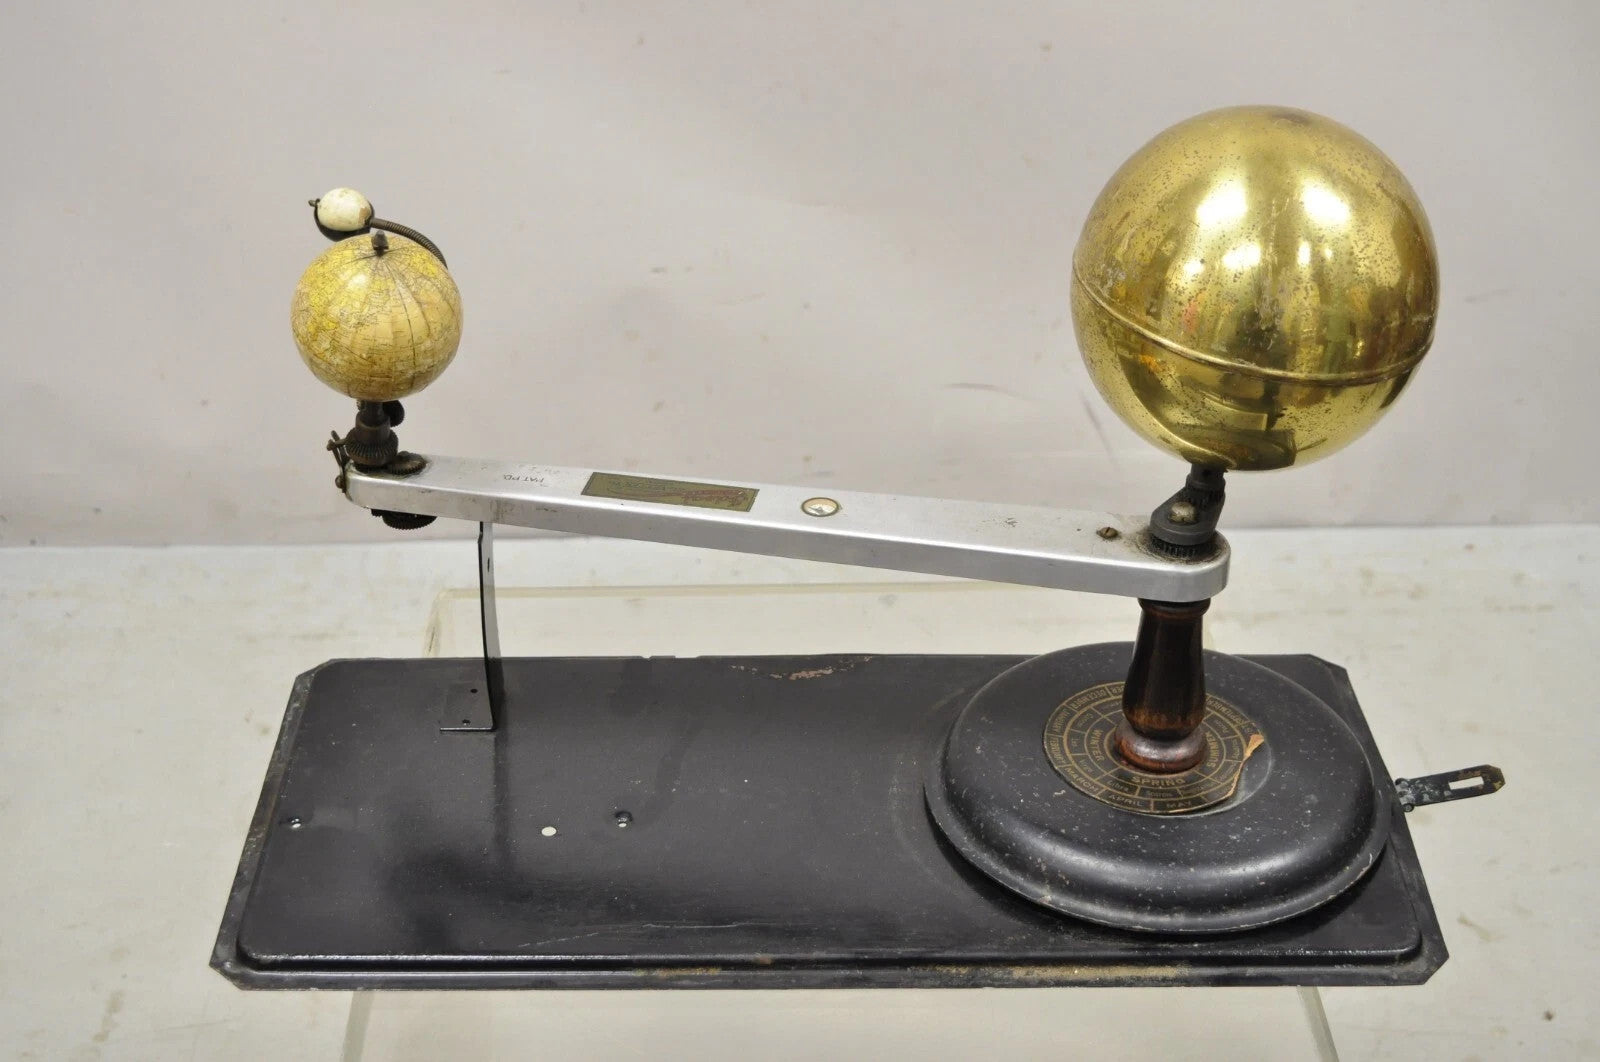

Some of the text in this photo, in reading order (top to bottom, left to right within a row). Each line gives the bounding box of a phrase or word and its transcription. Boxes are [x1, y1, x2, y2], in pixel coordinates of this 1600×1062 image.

[1070, 689, 1107, 709] DECEMBER
[1051, 708, 1071, 733] JANUARY
[1090, 729, 1106, 762] WINTER
[1204, 731, 1219, 768] SUMMER
[1064, 767, 1100, 793] MARCH
[1131, 776, 1187, 786] SPRING
[1108, 795, 1145, 807] APRIL
[1166, 801, 1193, 809] MAY
